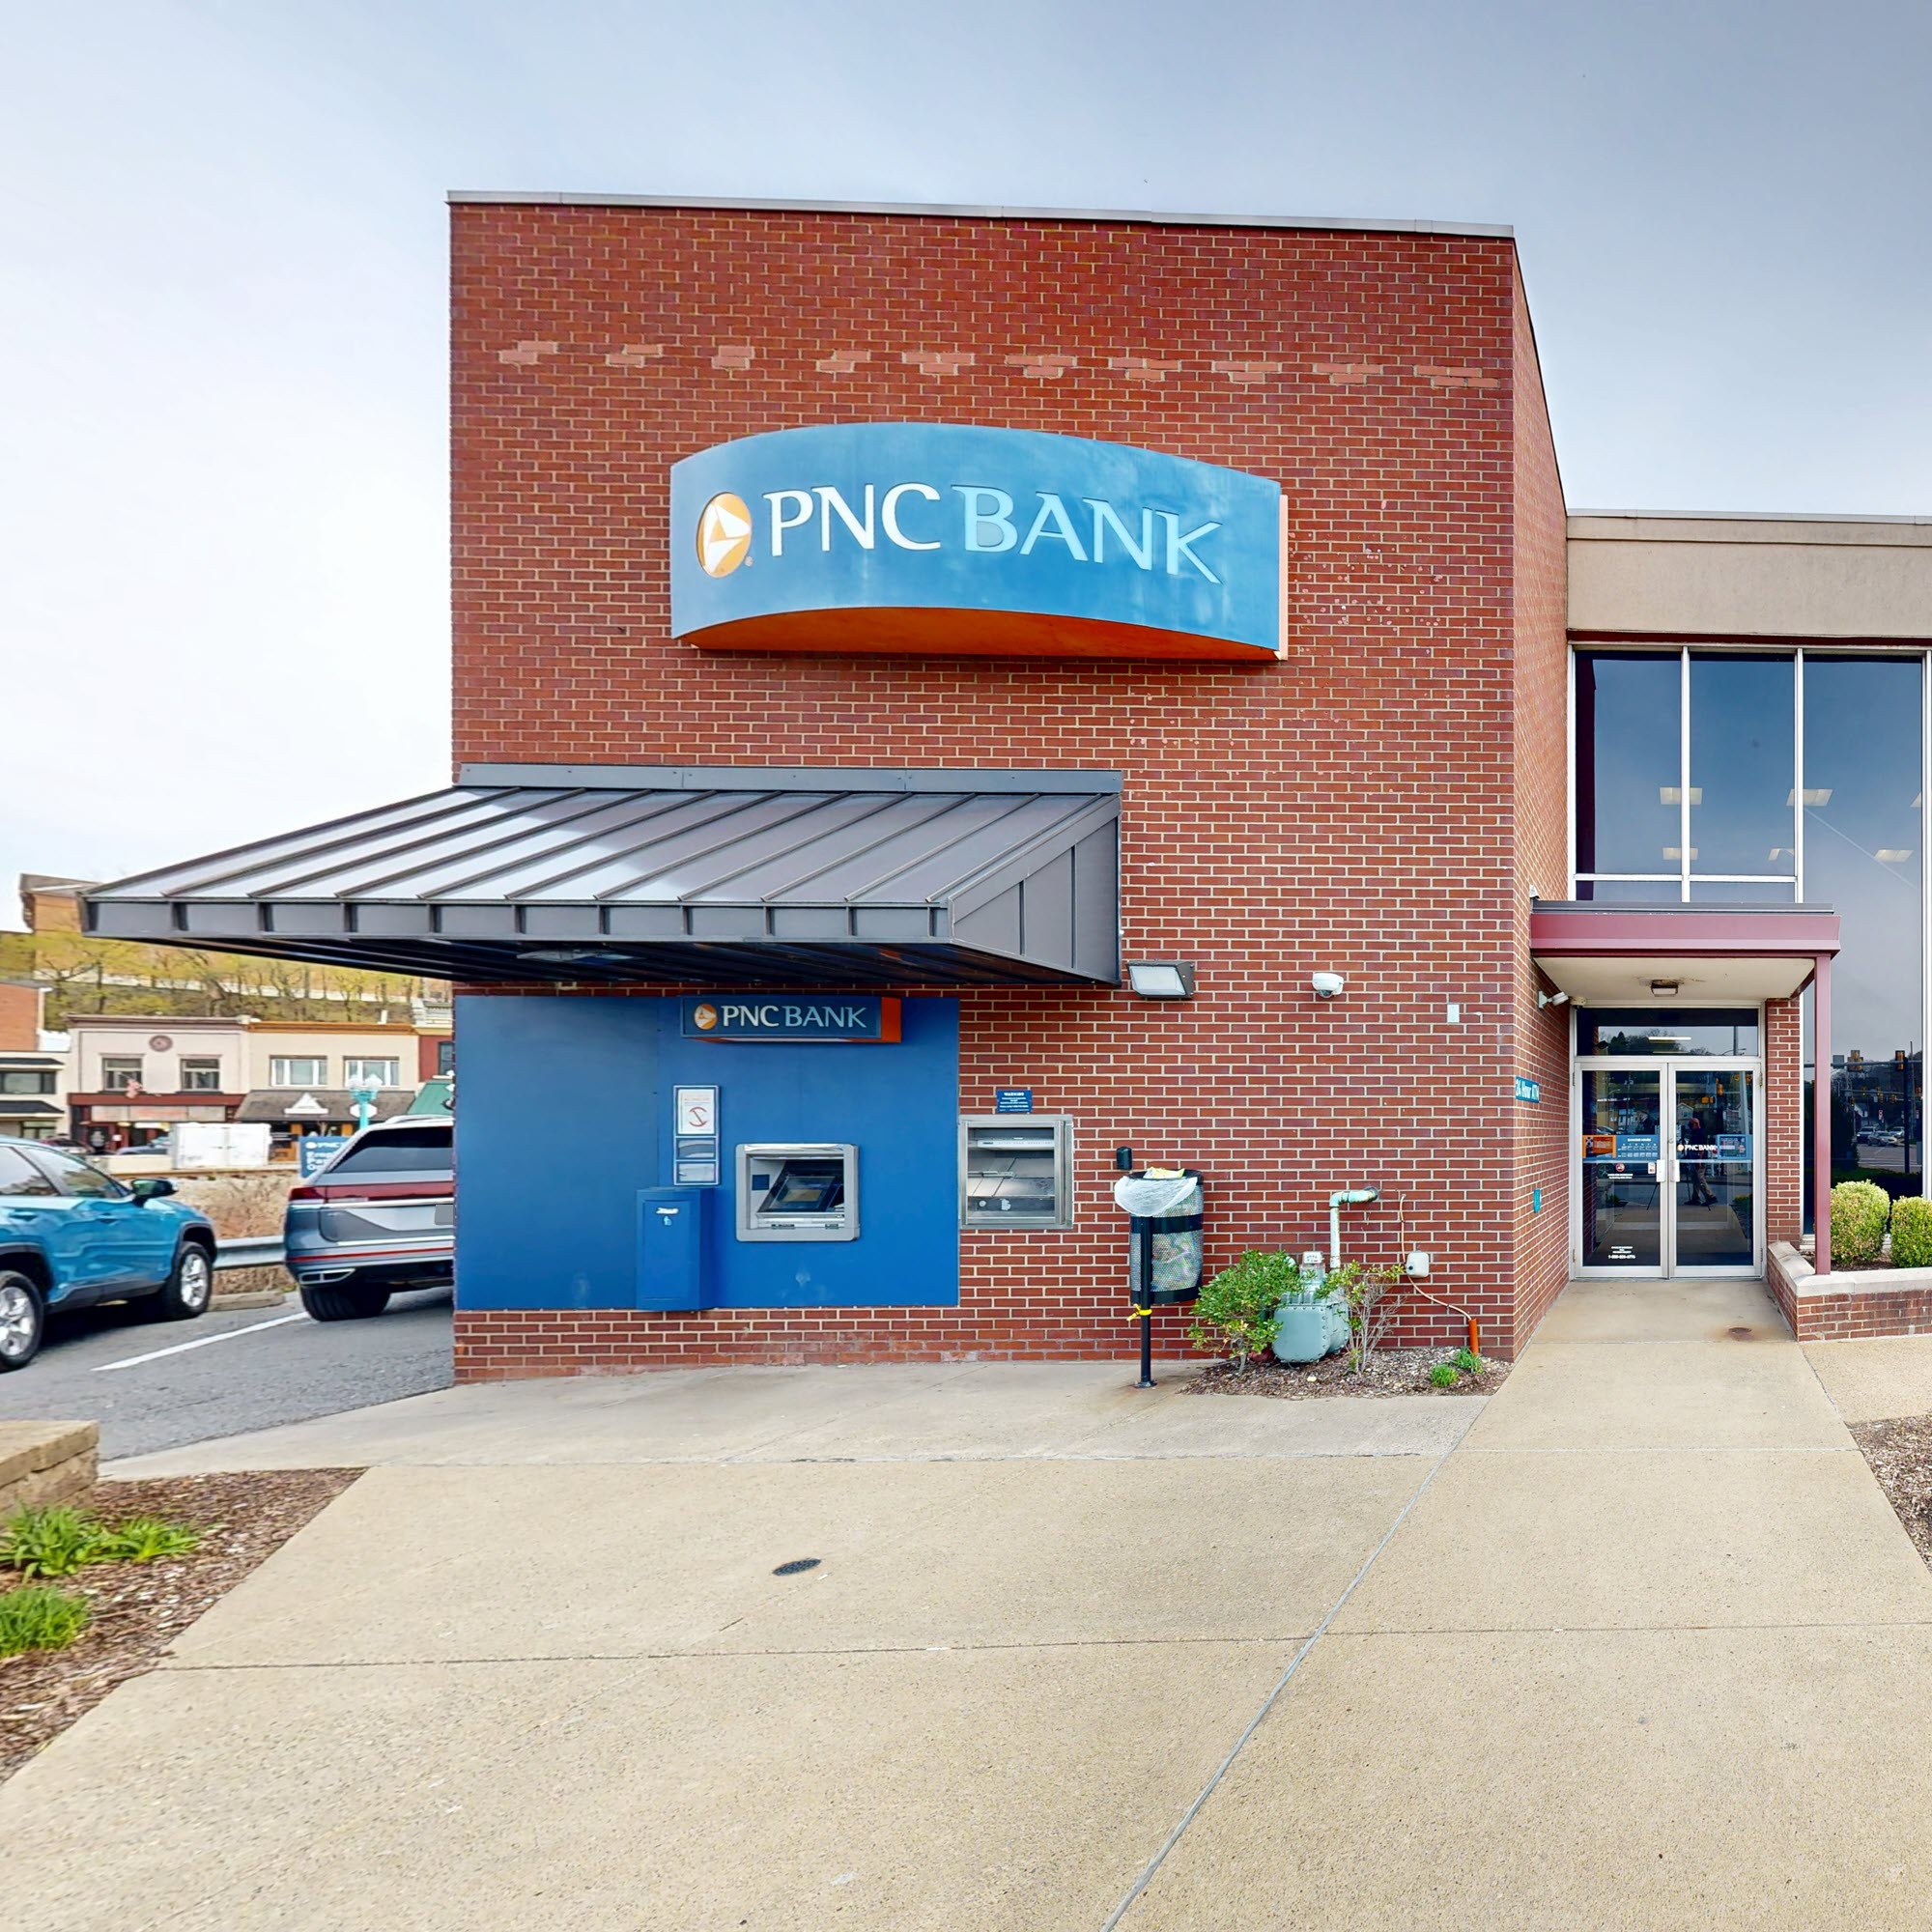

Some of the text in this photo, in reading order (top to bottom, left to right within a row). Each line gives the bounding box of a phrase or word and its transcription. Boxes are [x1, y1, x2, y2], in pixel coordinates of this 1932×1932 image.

[762, 482, 1224, 585] PNC BANK
[721, 1005, 867, 1028] PNC BANK
